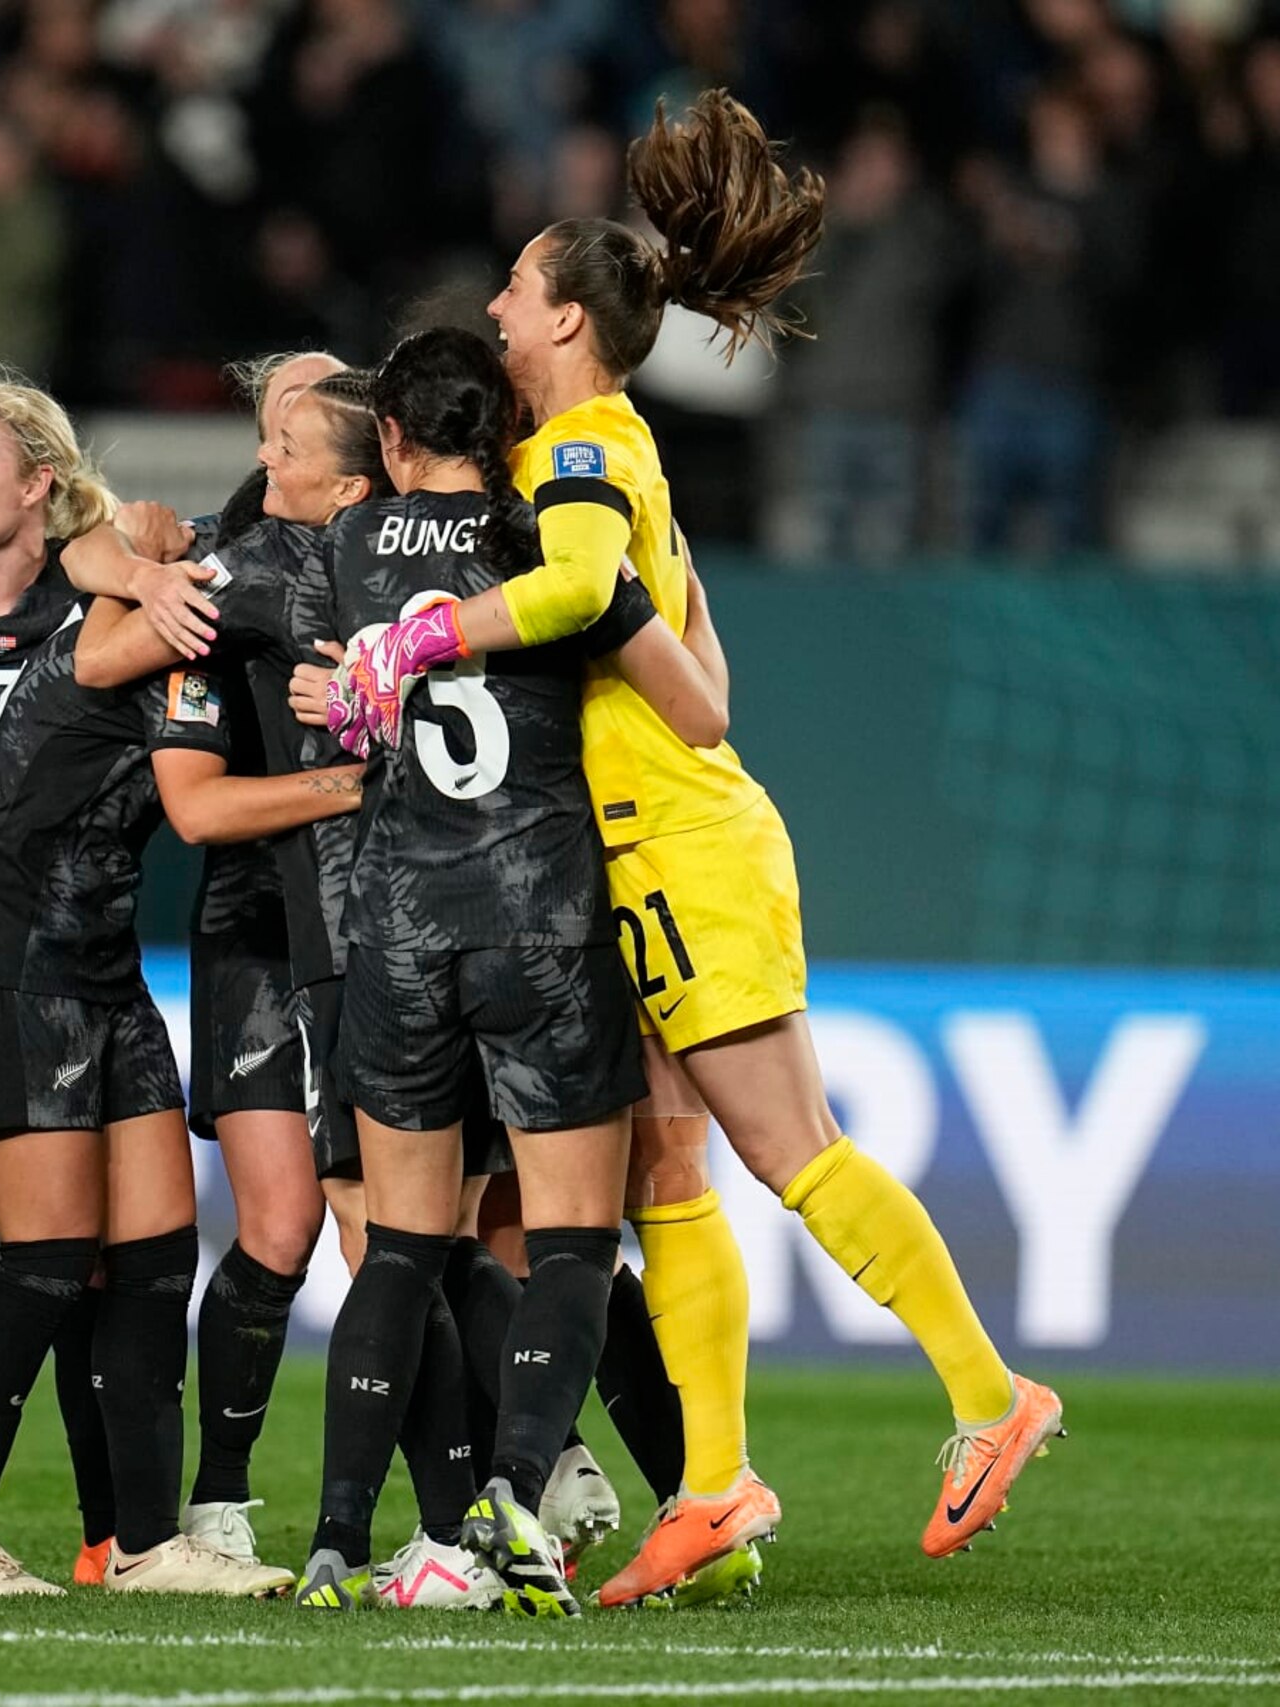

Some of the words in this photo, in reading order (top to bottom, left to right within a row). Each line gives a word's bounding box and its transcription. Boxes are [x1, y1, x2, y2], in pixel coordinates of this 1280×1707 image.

[376, 515, 490, 556] BUNG
[399, 589, 511, 800] 3
[613, 889, 697, 1000] 21
[513, 1350, 552, 1365] NZ
[350, 1376, 391, 1396] NZ
[448, 1445, 472, 1460] NZ
